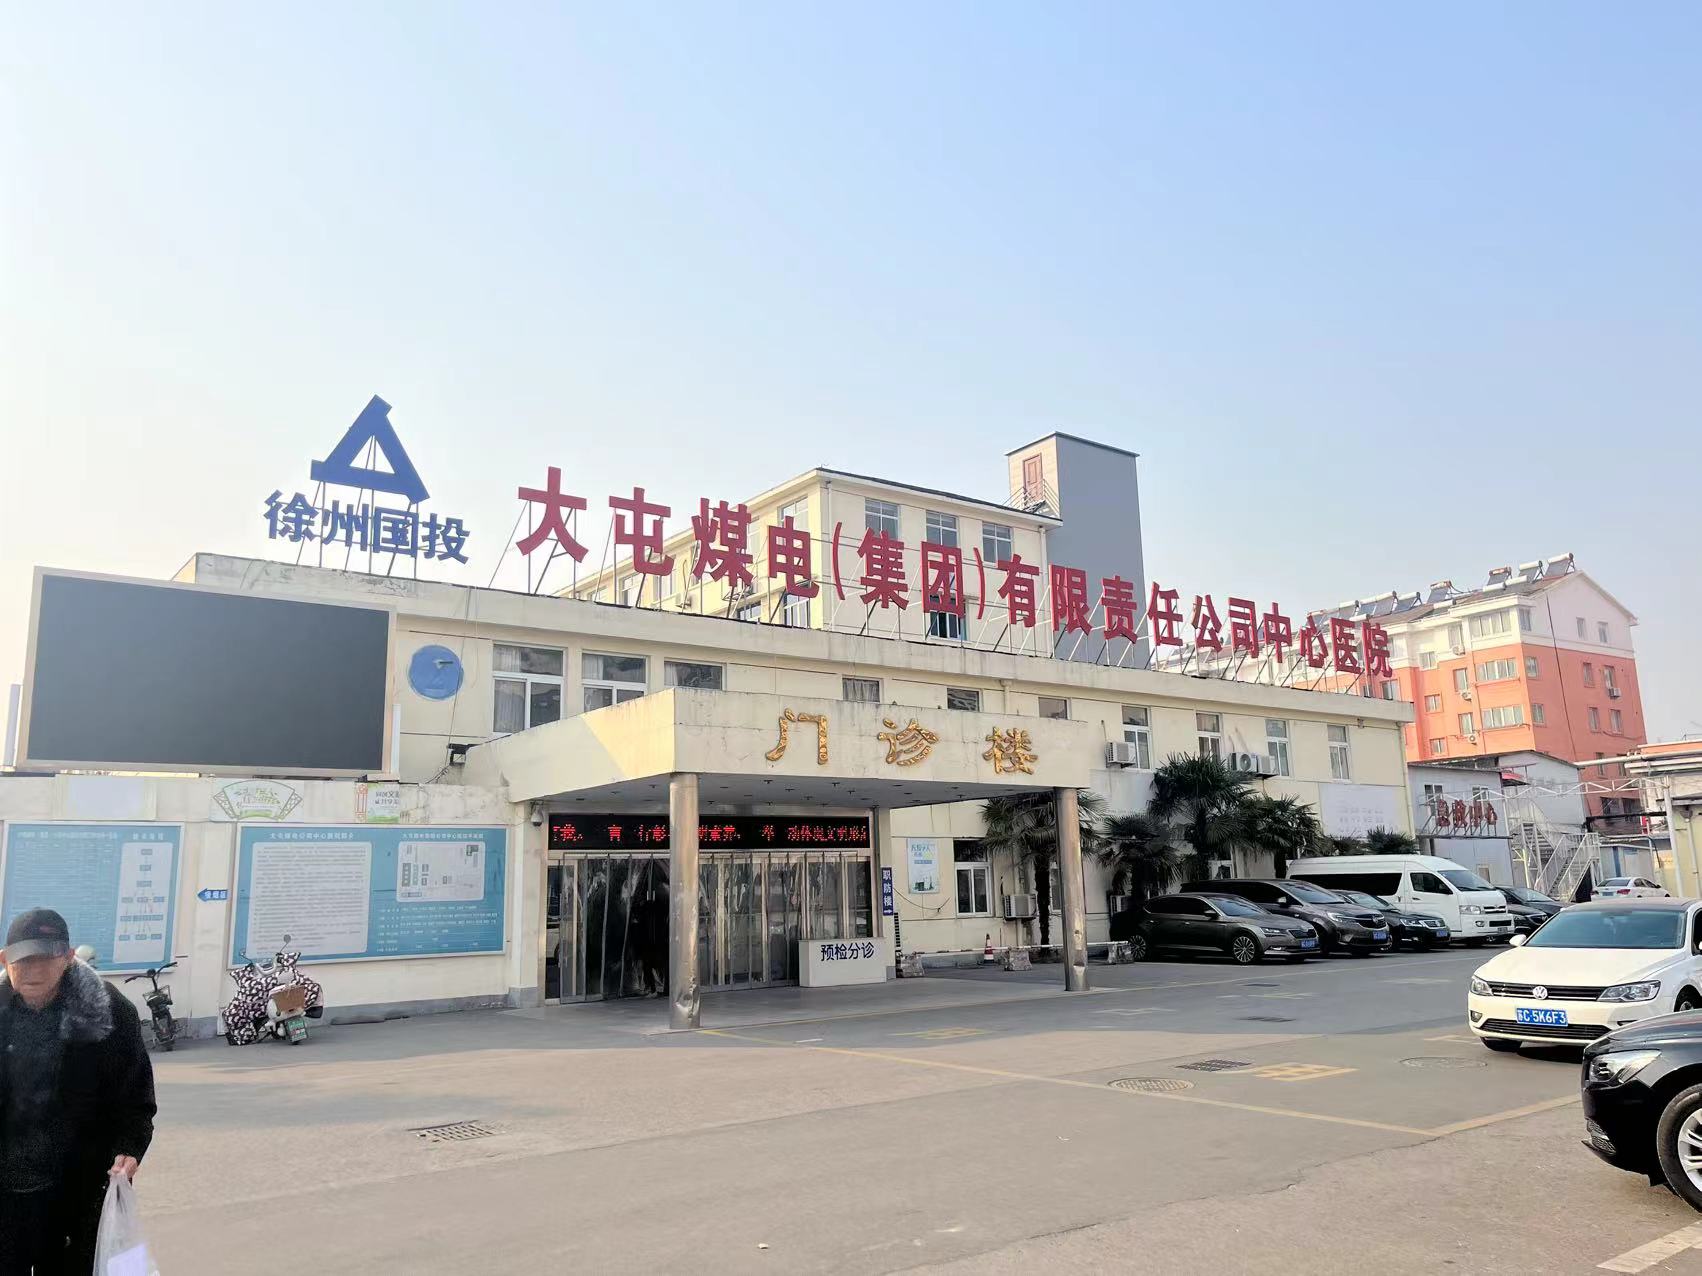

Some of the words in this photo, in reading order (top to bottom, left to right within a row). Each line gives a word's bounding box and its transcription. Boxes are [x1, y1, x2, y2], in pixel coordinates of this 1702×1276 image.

[264, 489, 470, 565] 徐州国投
[765, 708, 1038, 775] 门诊楼
[882, 869, 893, 906] 职防楼
[820, 941, 875, 961] 预检分诊
